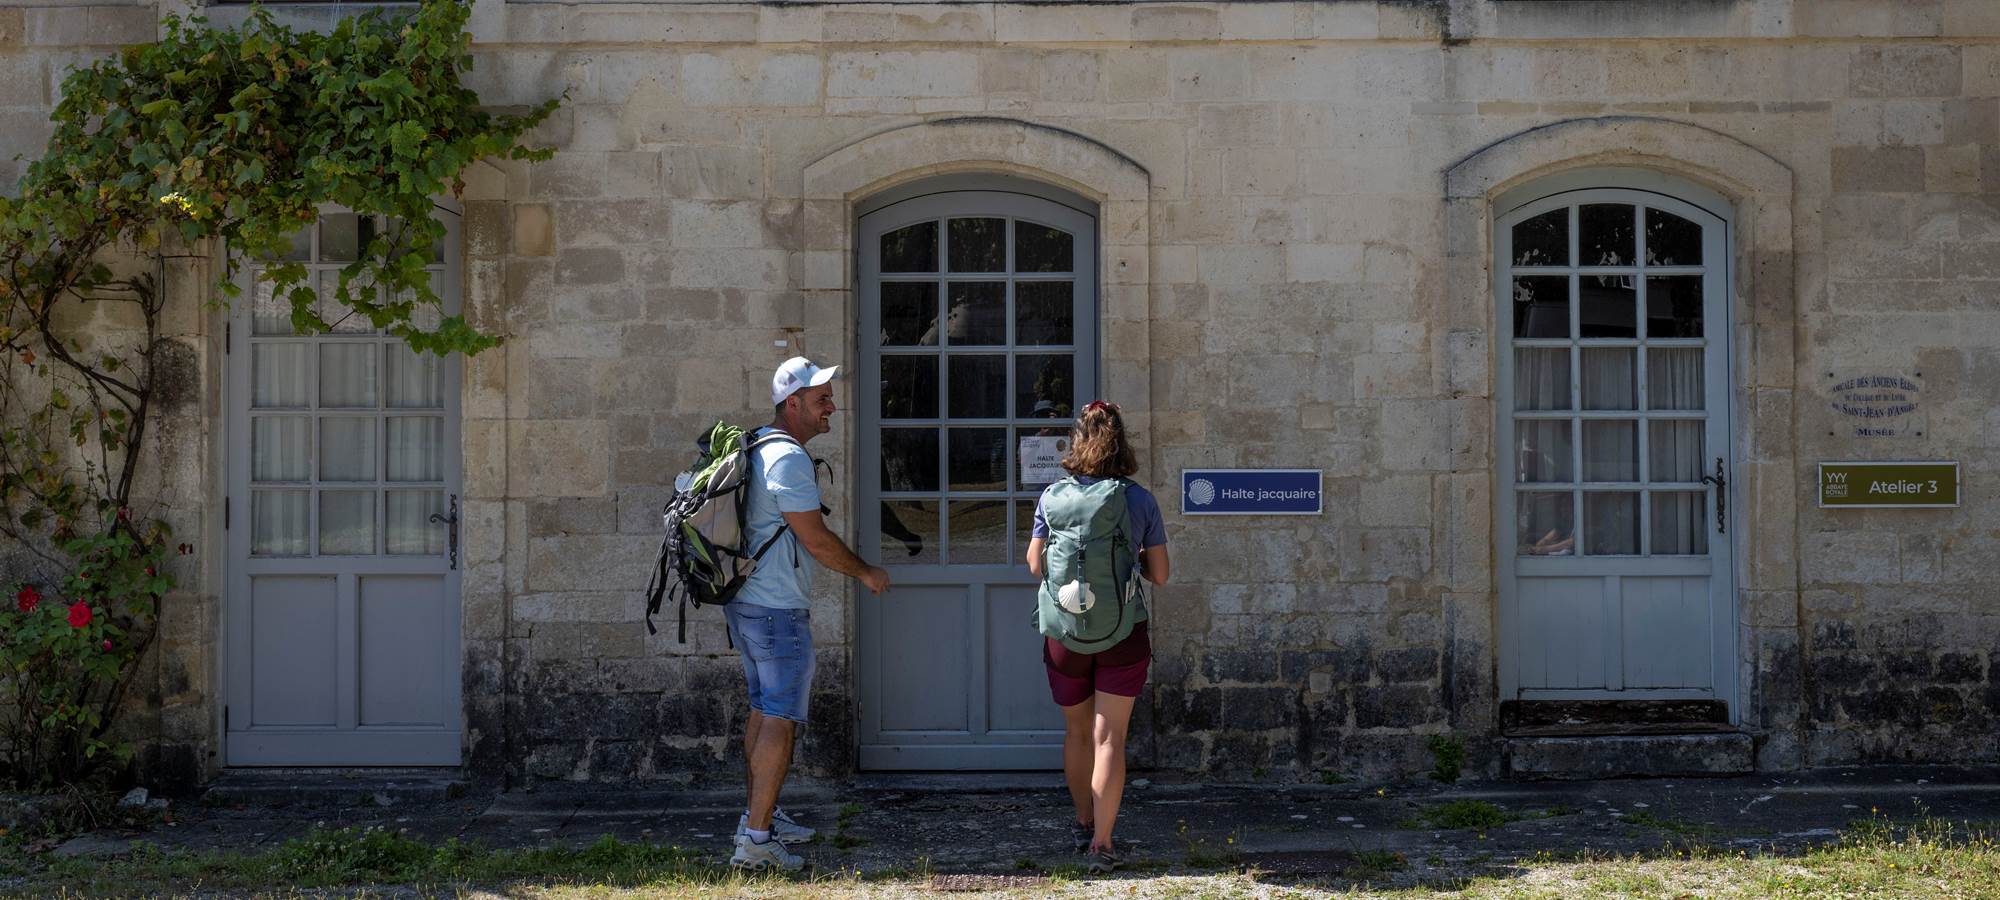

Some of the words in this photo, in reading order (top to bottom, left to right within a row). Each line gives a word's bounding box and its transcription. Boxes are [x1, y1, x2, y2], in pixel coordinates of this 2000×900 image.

[1871, 375, 1898, 389] ANCIENS
[1869, 480, 1923, 494] Atelier
[1927, 480, 1938, 494] 3
[1222, 488, 1255, 499] Halte
[1257, 488, 1316, 501] jacquaire
